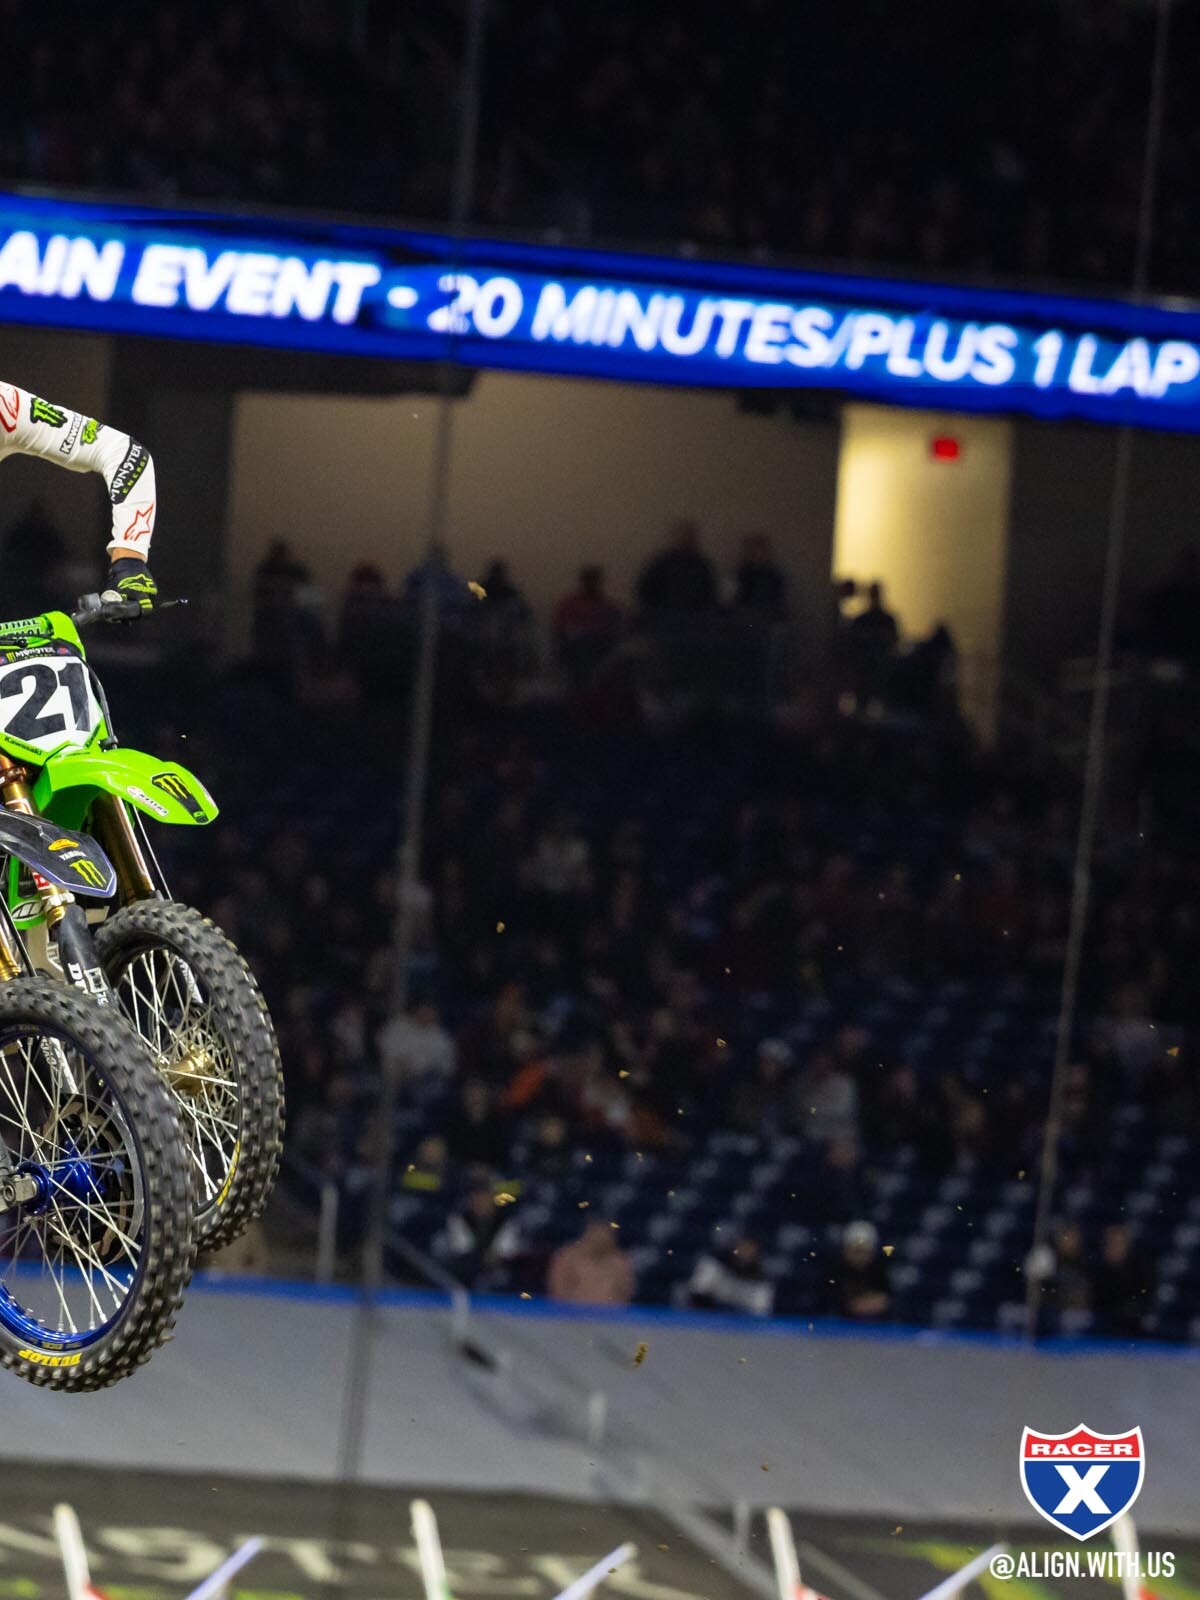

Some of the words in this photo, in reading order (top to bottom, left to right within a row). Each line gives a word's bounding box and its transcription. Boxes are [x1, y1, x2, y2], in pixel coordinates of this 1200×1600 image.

[132, 245, 381, 325] EVENT
[428, 273, 523, 337] 20
[532, 283, 1018, 386] MINUTES/PLUS
[1033, 330, 1062, 388] 1
[1069, 335, 1200, 398] LAP
[111, 444, 142, 502] MONSTER
[0, 662, 91, 741] 21
[59, 850, 87, 860] YAMAHA
[18, 1349, 83, 1367] DUNLOP
